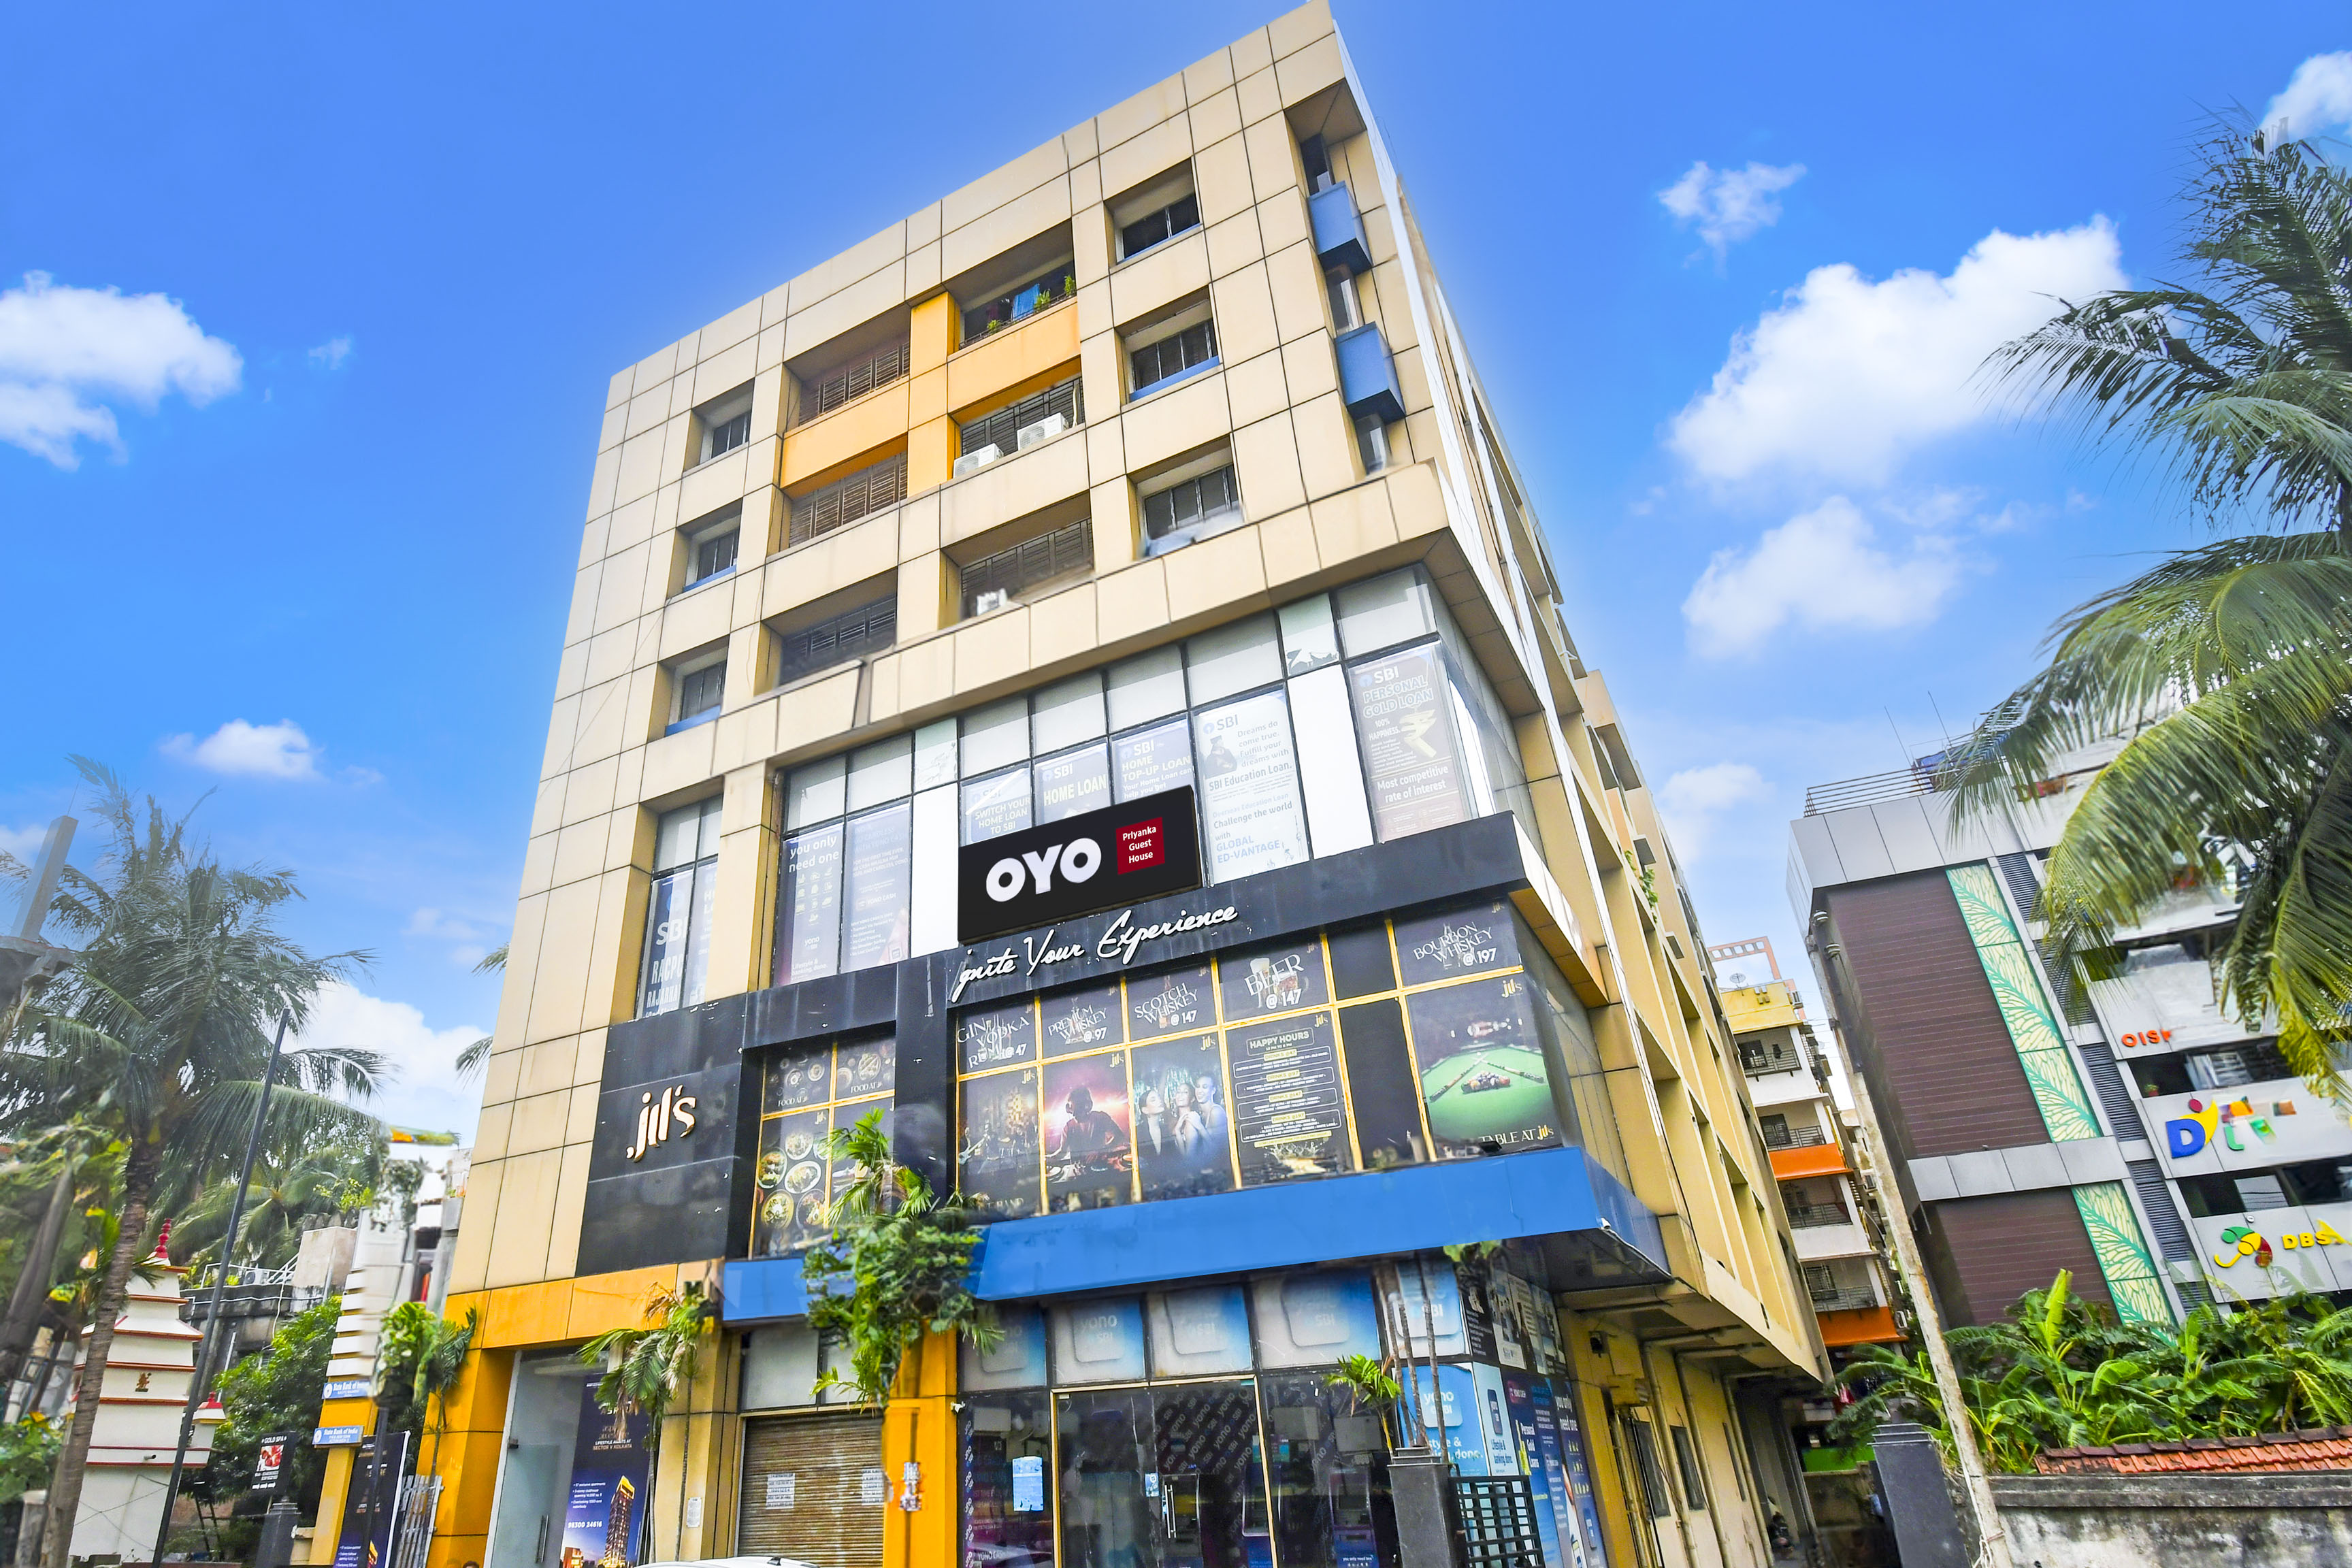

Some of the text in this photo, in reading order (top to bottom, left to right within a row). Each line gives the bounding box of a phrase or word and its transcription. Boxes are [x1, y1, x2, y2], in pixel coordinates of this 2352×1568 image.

[1374, 666, 1399, 684] SBI
[1363, 674, 1428, 704] PERSONAL
[1363, 687, 1434, 719] GOLD LOAN
[1216, 715, 1239, 731] SBI
[1237, 721, 1278, 738] Dreams do
[1369, 726, 1401, 741] HAPPINESS.
[1375, 718, 1390, 728] 100%
[1134, 740, 1154, 756] SBI
[1239, 732, 1279, 747] come true.
[1240, 741, 1281, 757] Fulfill your
[1122, 755, 1153, 772] HOME
[1123, 755, 1191, 782] TOP-UP LOAN
[1241, 749, 1289, 768] dreams with
[1054, 764, 1073, 779] SBI
[1124, 782, 1139, 791] Your
[1140, 777, 1160, 787] Home
[1161, 772, 1178, 781] Loan
[1209, 778, 1222, 791] SBI
[1224, 767, 1267, 787] Education
[1268, 760, 1292, 775] Loan.
[1377, 765, 1449, 791] Most competitive
[1043, 774, 1107, 806] HOME LOAN
[1124, 789, 1139, 800] help
[1140, 785, 1153, 796] you
[1385, 779, 1446, 804] rate of interest
[975, 797, 1030, 819] SWITCH YOUR
[1213, 793, 1289, 818] Overseas Education Loan
[1213, 801, 1292, 829] Challenge the world
[979, 808, 1027, 828] HOME LOAN
[991, 821, 1015, 834] TO SBI
[1123, 826, 1157, 840] Priyanka
[1215, 831, 1230, 841] with
[1216, 835, 1254, 851] GLOBAL
[790, 835, 837, 860] you only
[1129, 838, 1152, 851] Guest
[1217, 840, 1280, 864] ED-VANTAGE
[789, 851, 839, 873] need one
[1128, 851, 1153, 864] House
[986, 838, 1102, 902] OYO
[804, 936, 820, 947] yono
[1024, 930, 1085, 975] Your
[1097, 906, 1239, 965] Experience
[1414, 921, 1477, 960] BOURBON
[1433, 927, 1492, 962] WHISKEY
[1463, 948, 1497, 966] @ 197
[1244, 954, 1304, 996] BEER
[647, 985, 681, 1008] RAJARHA
[1134, 983, 1188, 1018] SCOTCH
[1143, 989, 1198, 1024] WHISKEY
[1267, 988, 1301, 1009] @ 147
[1047, 1004, 1093, 1036] PREMIUM
[1059, 1007, 1107, 1040] WHISKEY
[1171, 1009, 1197, 1026] @ 147
[957, 1017, 987, 1043] GIN
[976, 1016, 1030, 1048] VODKA
[1083, 1027, 1107, 1043] @ 97
[1250, 1030, 1309, 1049] HAPPY HOURS
[968, 1043, 1002, 1068] RUM
[1015, 1043, 1027, 1055] 47
[1267, 1072, 1286, 1081] DRINKS
[851, 1083, 867, 1094] FOOD
[1270, 1093, 1288, 1101] DRINKS
[778, 1098, 795, 1107] FOOD
[1522, 1129, 1536, 1142] AT
[1079, 1315, 1117, 1333] yono
[1218, 1392, 1235, 1418] yono
[1192, 1404, 1210, 1428] yono
[1238, 1414, 1256, 1439] yono
[1188, 1435, 1205, 1460] yono
[1213, 1425, 1231, 1450] yono
